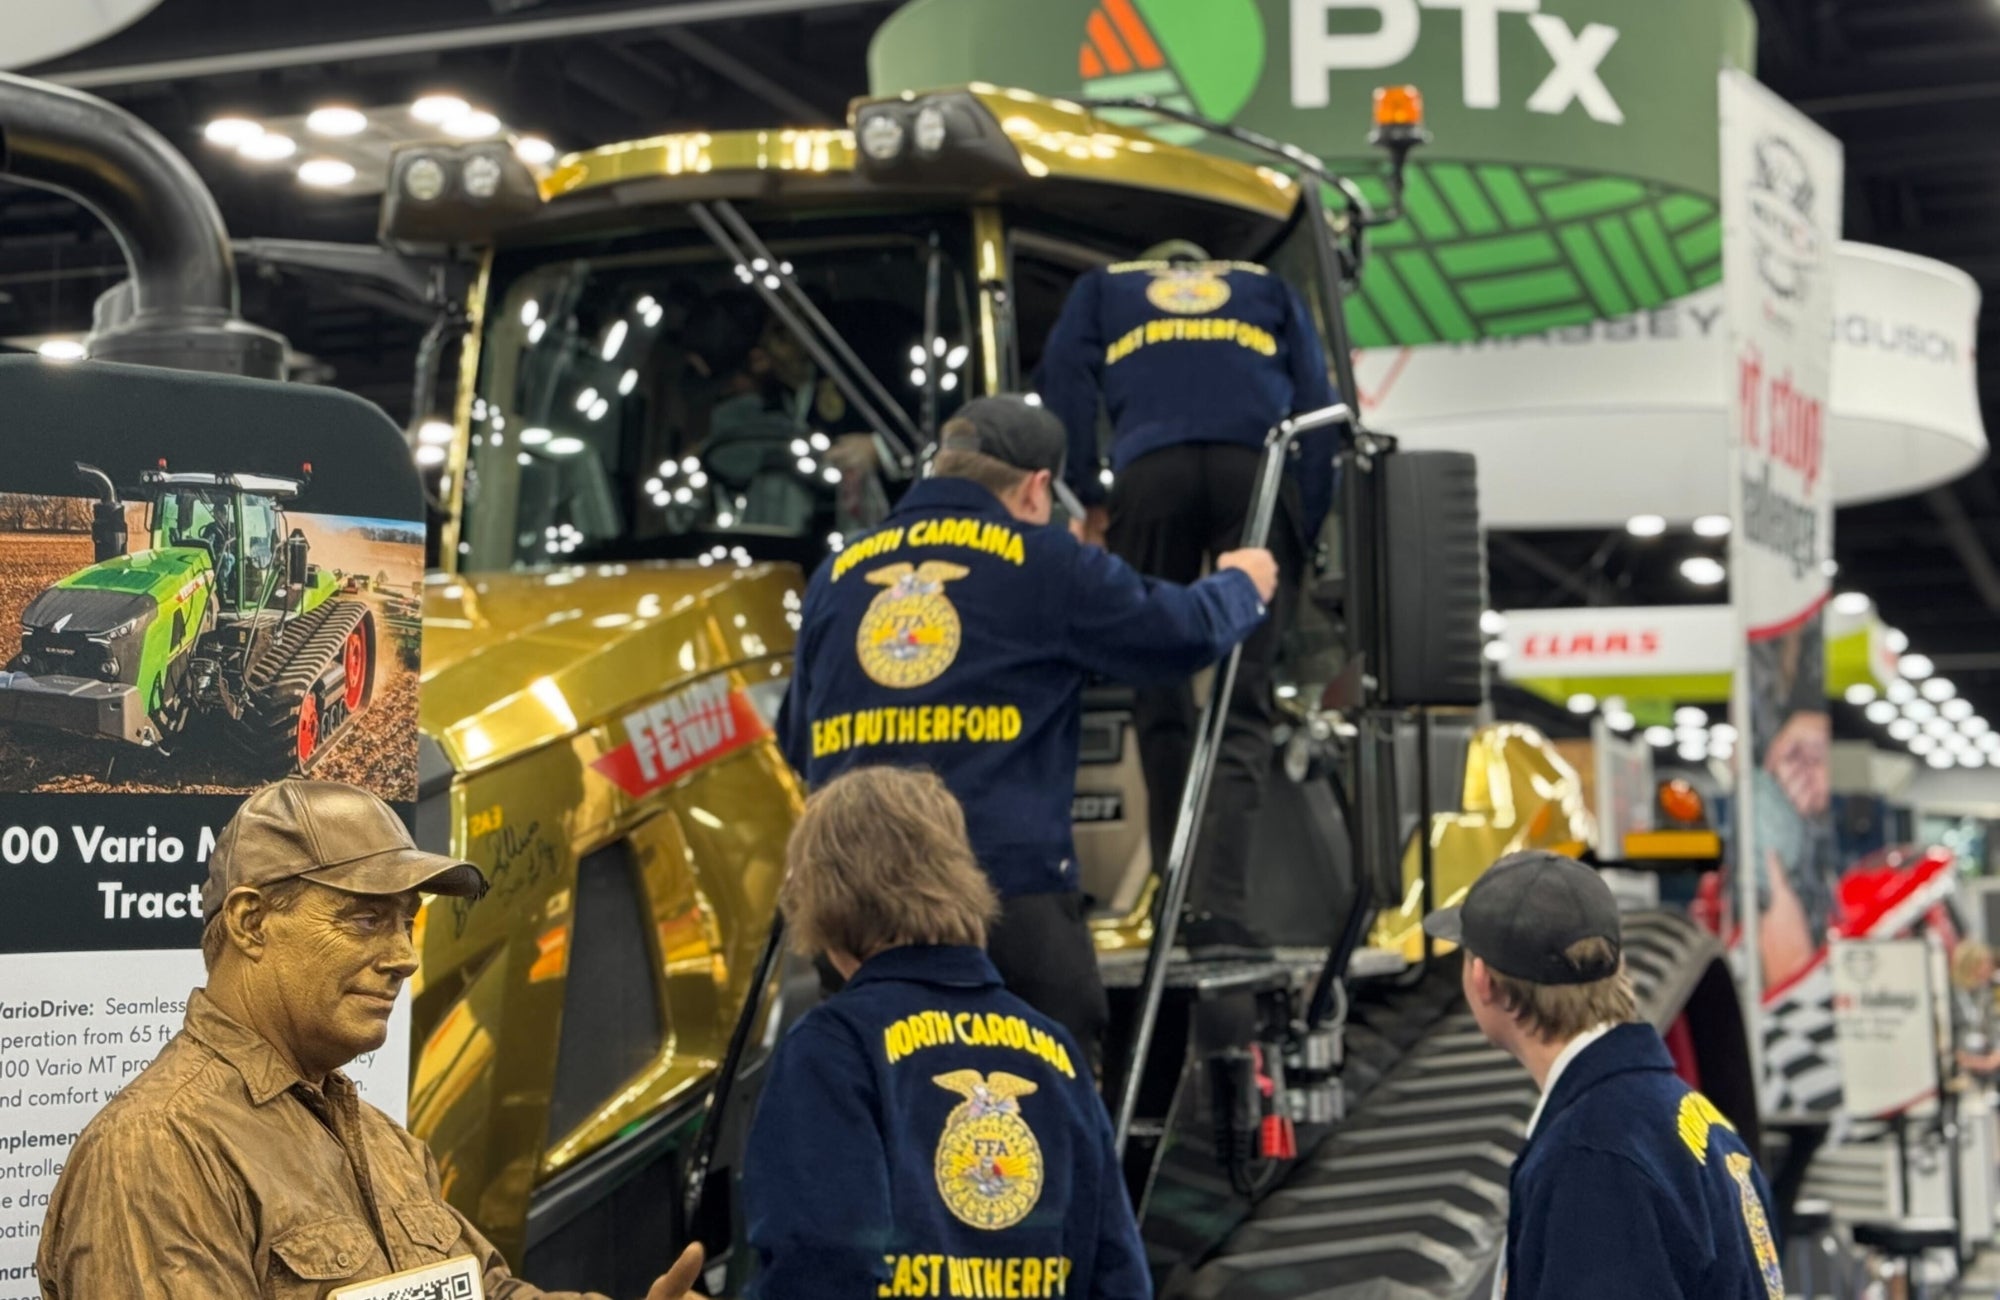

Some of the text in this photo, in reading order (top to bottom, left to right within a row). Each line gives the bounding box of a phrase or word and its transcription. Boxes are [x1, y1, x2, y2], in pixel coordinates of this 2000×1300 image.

[1290, 0, 1624, 125] PTx
[907, 517, 1025, 566] CAROLINA
[854, 704, 1022, 747] RUTHERFORD
[1, 825, 59, 864] 00
[71, 825, 185, 863] Vario
[98, 881, 203, 919] Tract
[105, 996, 186, 1015] Seamless
[84, 1027, 123, 1045] from
[129, 1025, 152, 1043] 65
[884, 1010, 1076, 1079] NORTH CAROLINA
[36, 1058, 82, 1076] Vario
[88, 1055, 117, 1074] MT
[28, 1087, 98, 1106] comfort
[974, 1139, 1009, 1157] FFA
